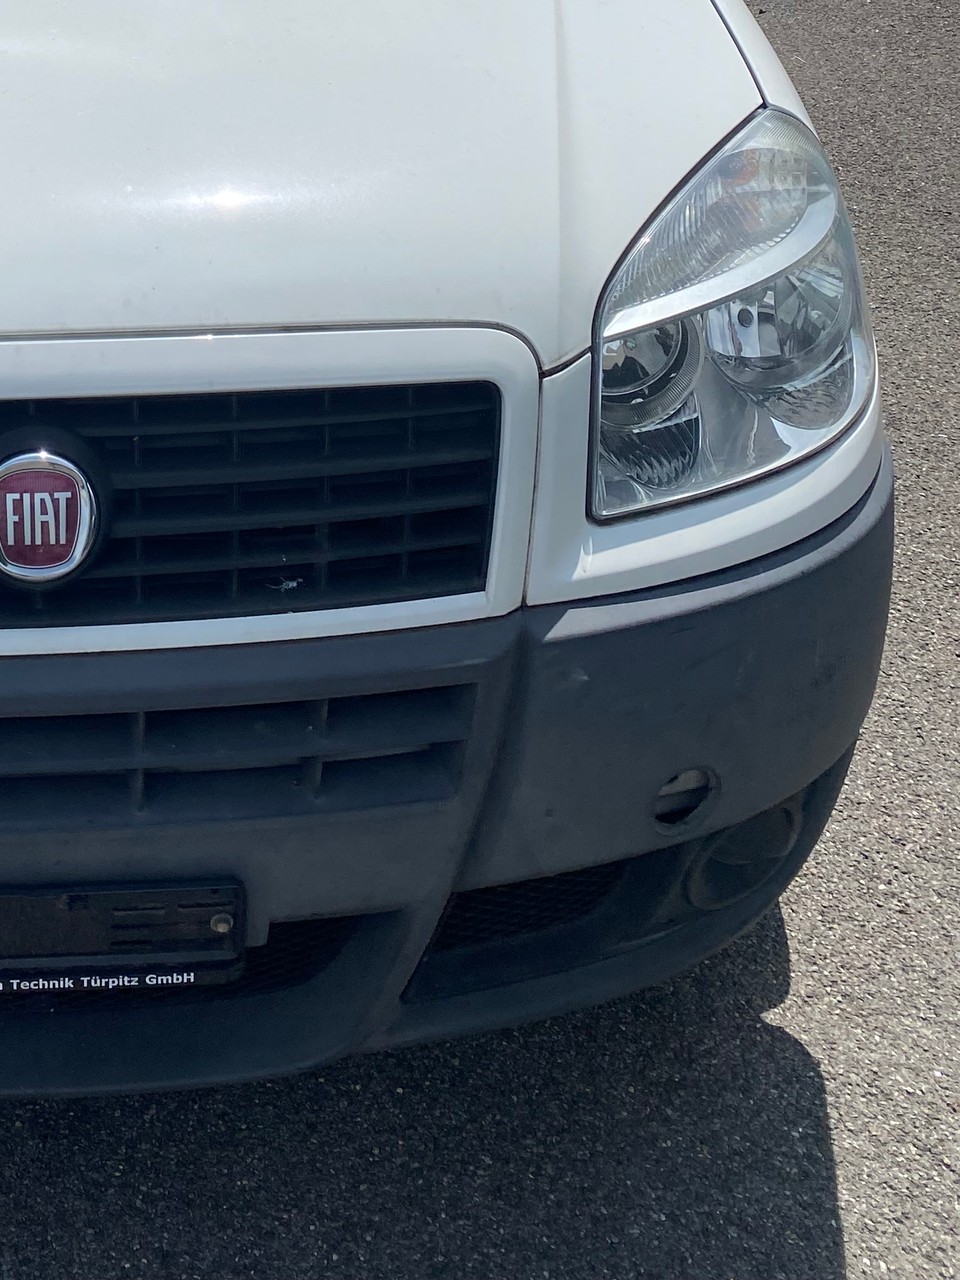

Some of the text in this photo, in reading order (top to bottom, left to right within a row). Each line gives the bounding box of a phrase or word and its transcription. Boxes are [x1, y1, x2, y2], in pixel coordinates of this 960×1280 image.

[5, 491, 72, 546] FIAT
[9, 977, 74, 990] Technik
[80, 975, 139, 989] Türpitz
[145, 972, 195, 985] GmbH
